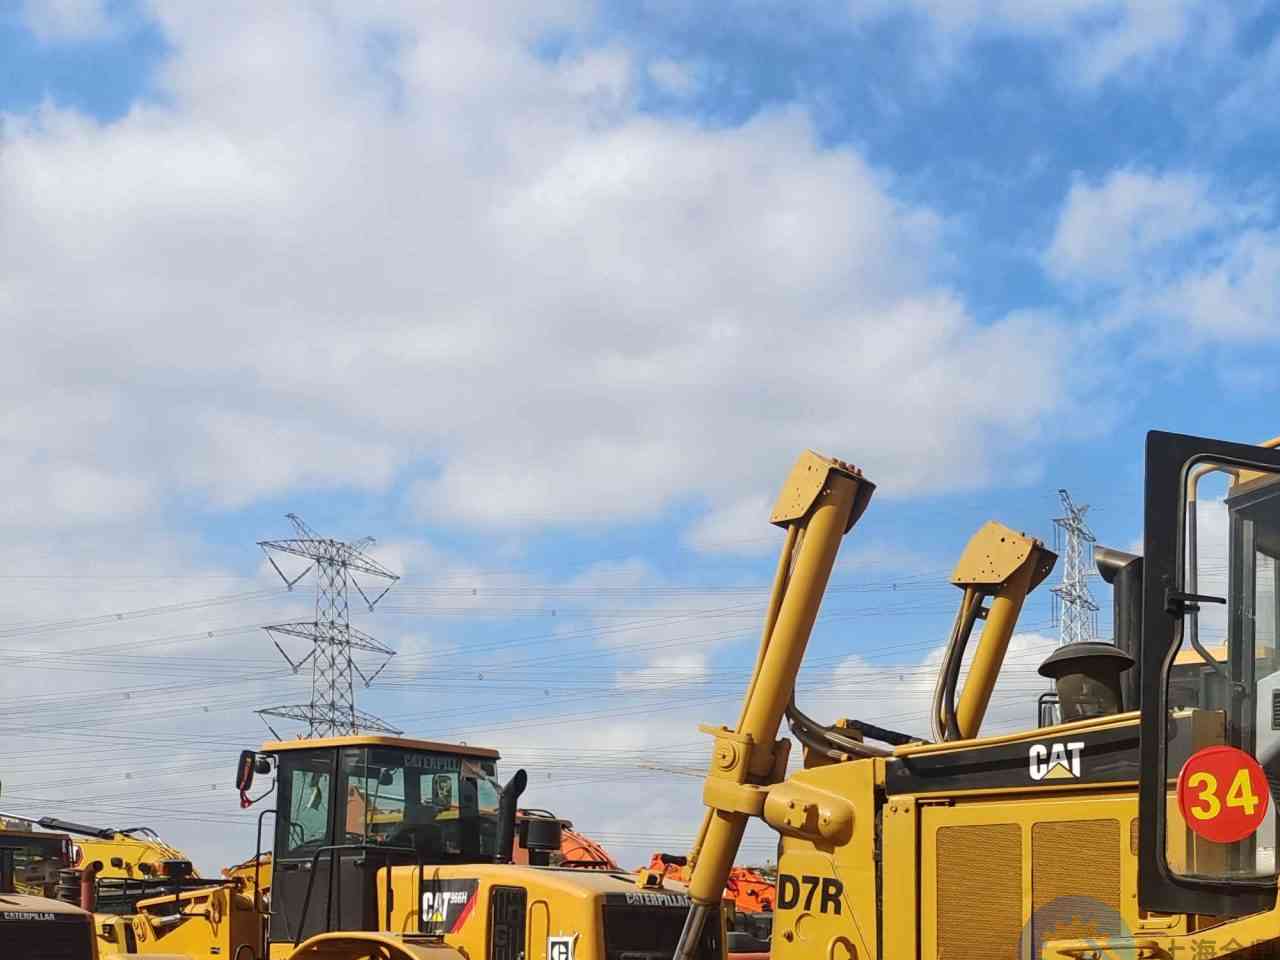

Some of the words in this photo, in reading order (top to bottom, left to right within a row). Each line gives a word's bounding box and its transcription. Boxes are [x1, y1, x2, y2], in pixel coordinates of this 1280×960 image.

[1028, 742, 1085, 781] CAT
[1187, 768, 1259, 821] 34
[422, 892, 450, 922] CAT
[777, 874, 844, 916] D7R
[3, 912, 56, 921] CATERPILLAR
